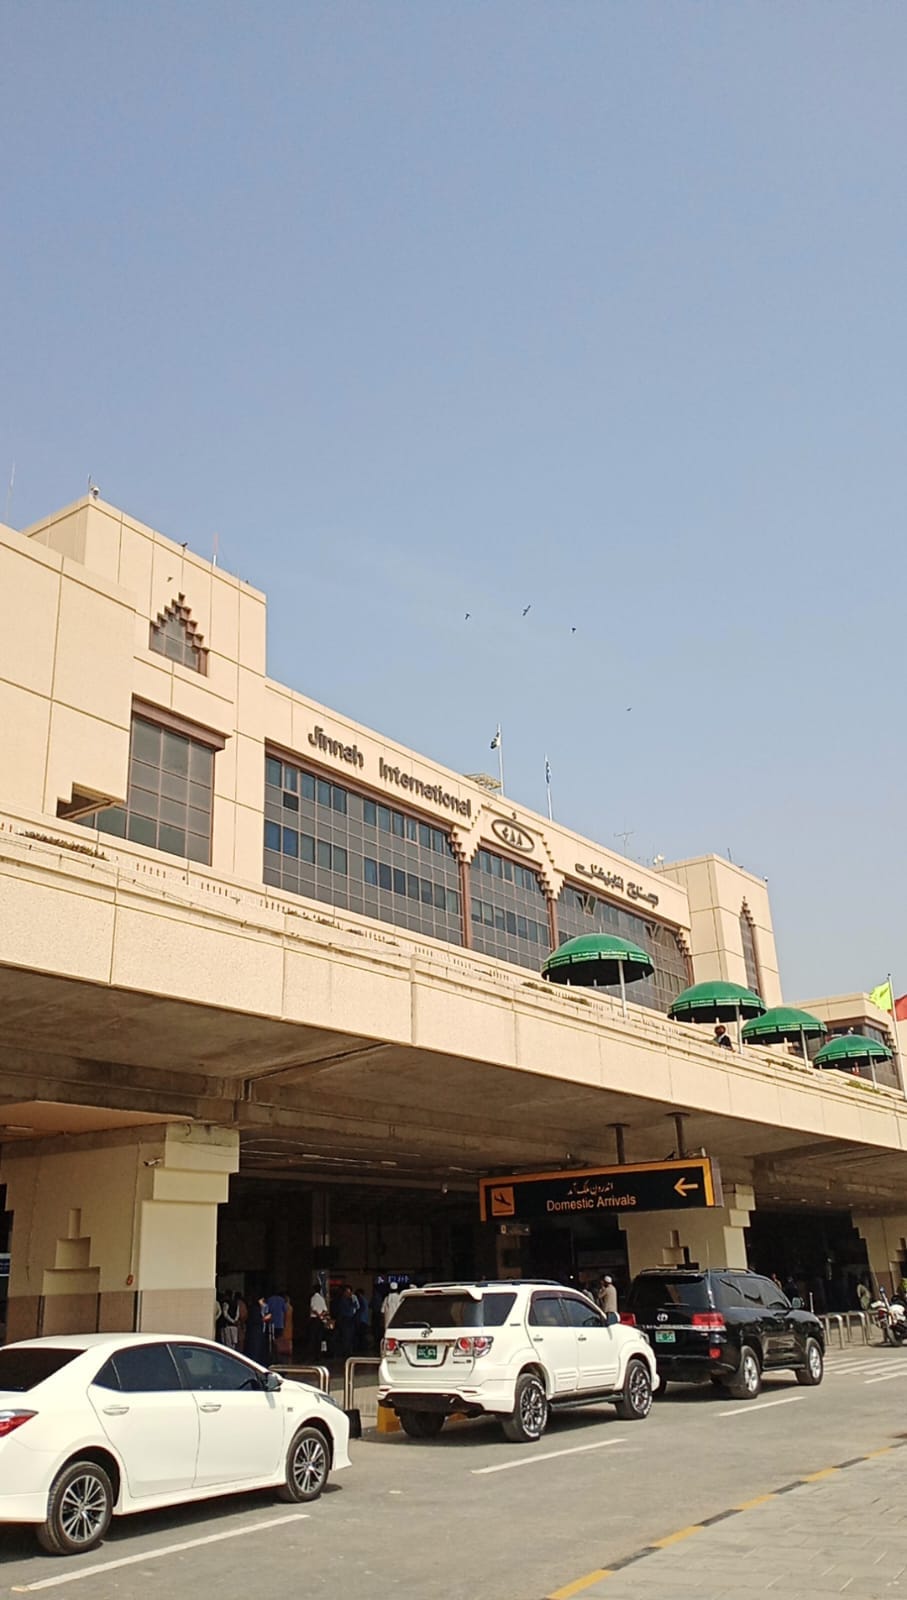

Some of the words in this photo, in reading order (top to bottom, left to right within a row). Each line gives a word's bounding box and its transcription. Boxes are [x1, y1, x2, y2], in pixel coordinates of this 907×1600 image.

[308, 725, 364, 768] Jinnah
[379, 757, 471, 818] International
[546, 1198, 594, 1212] Domestic
[596, 1194, 637, 1208] Arrivals
